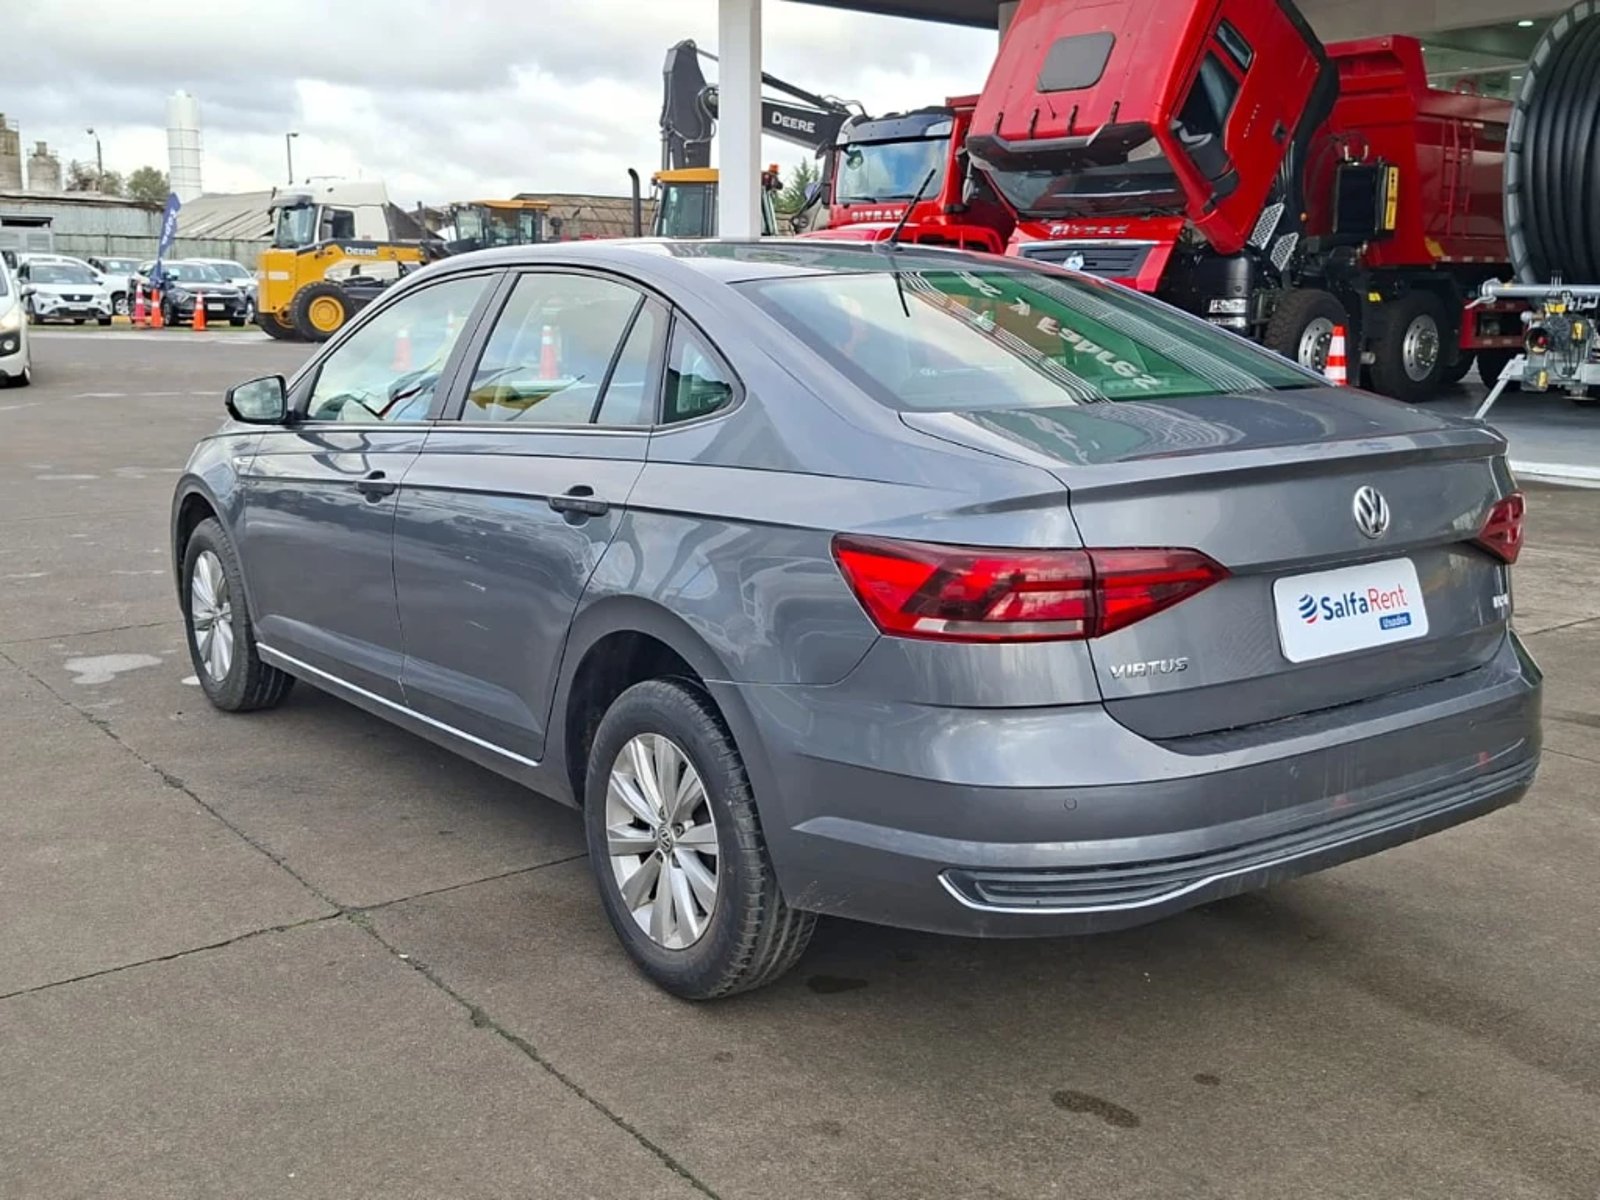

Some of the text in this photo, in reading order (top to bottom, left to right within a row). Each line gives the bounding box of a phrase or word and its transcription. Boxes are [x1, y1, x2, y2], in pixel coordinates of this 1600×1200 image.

[772, 111, 816, 133] DEERE
[1320, 584, 1408, 620] SalfaRent
[1110, 657, 1189, 679] VIRTUS
